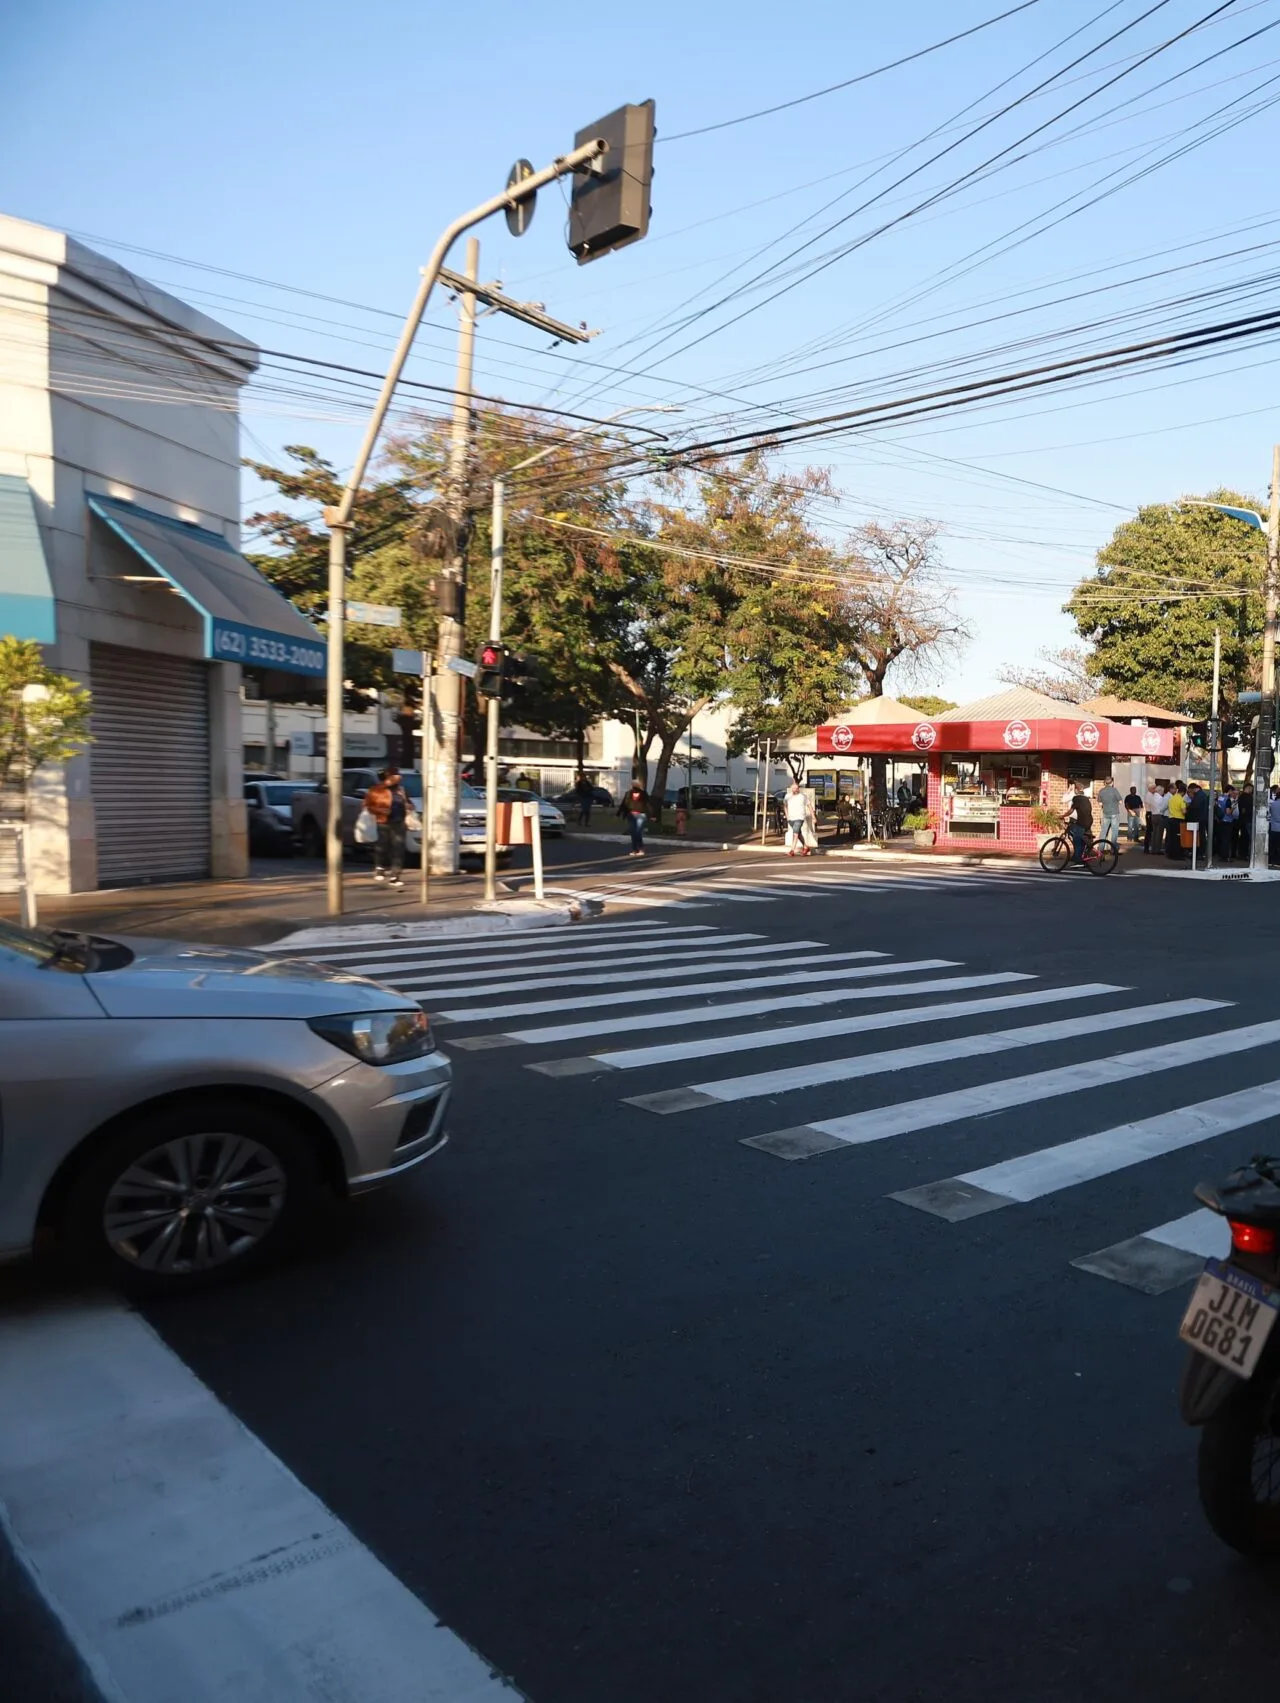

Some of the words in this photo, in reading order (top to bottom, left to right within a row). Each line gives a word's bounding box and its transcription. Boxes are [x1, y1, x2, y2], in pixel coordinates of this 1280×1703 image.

[214, 628, 248, 657] (62)
[249, 636, 324, 669] 3533-2000
[1226, 1273, 1257, 1296] BRASIL
[1208, 1284, 1260, 1331] JIM
[1189, 1308, 1253, 1366] 0G81
